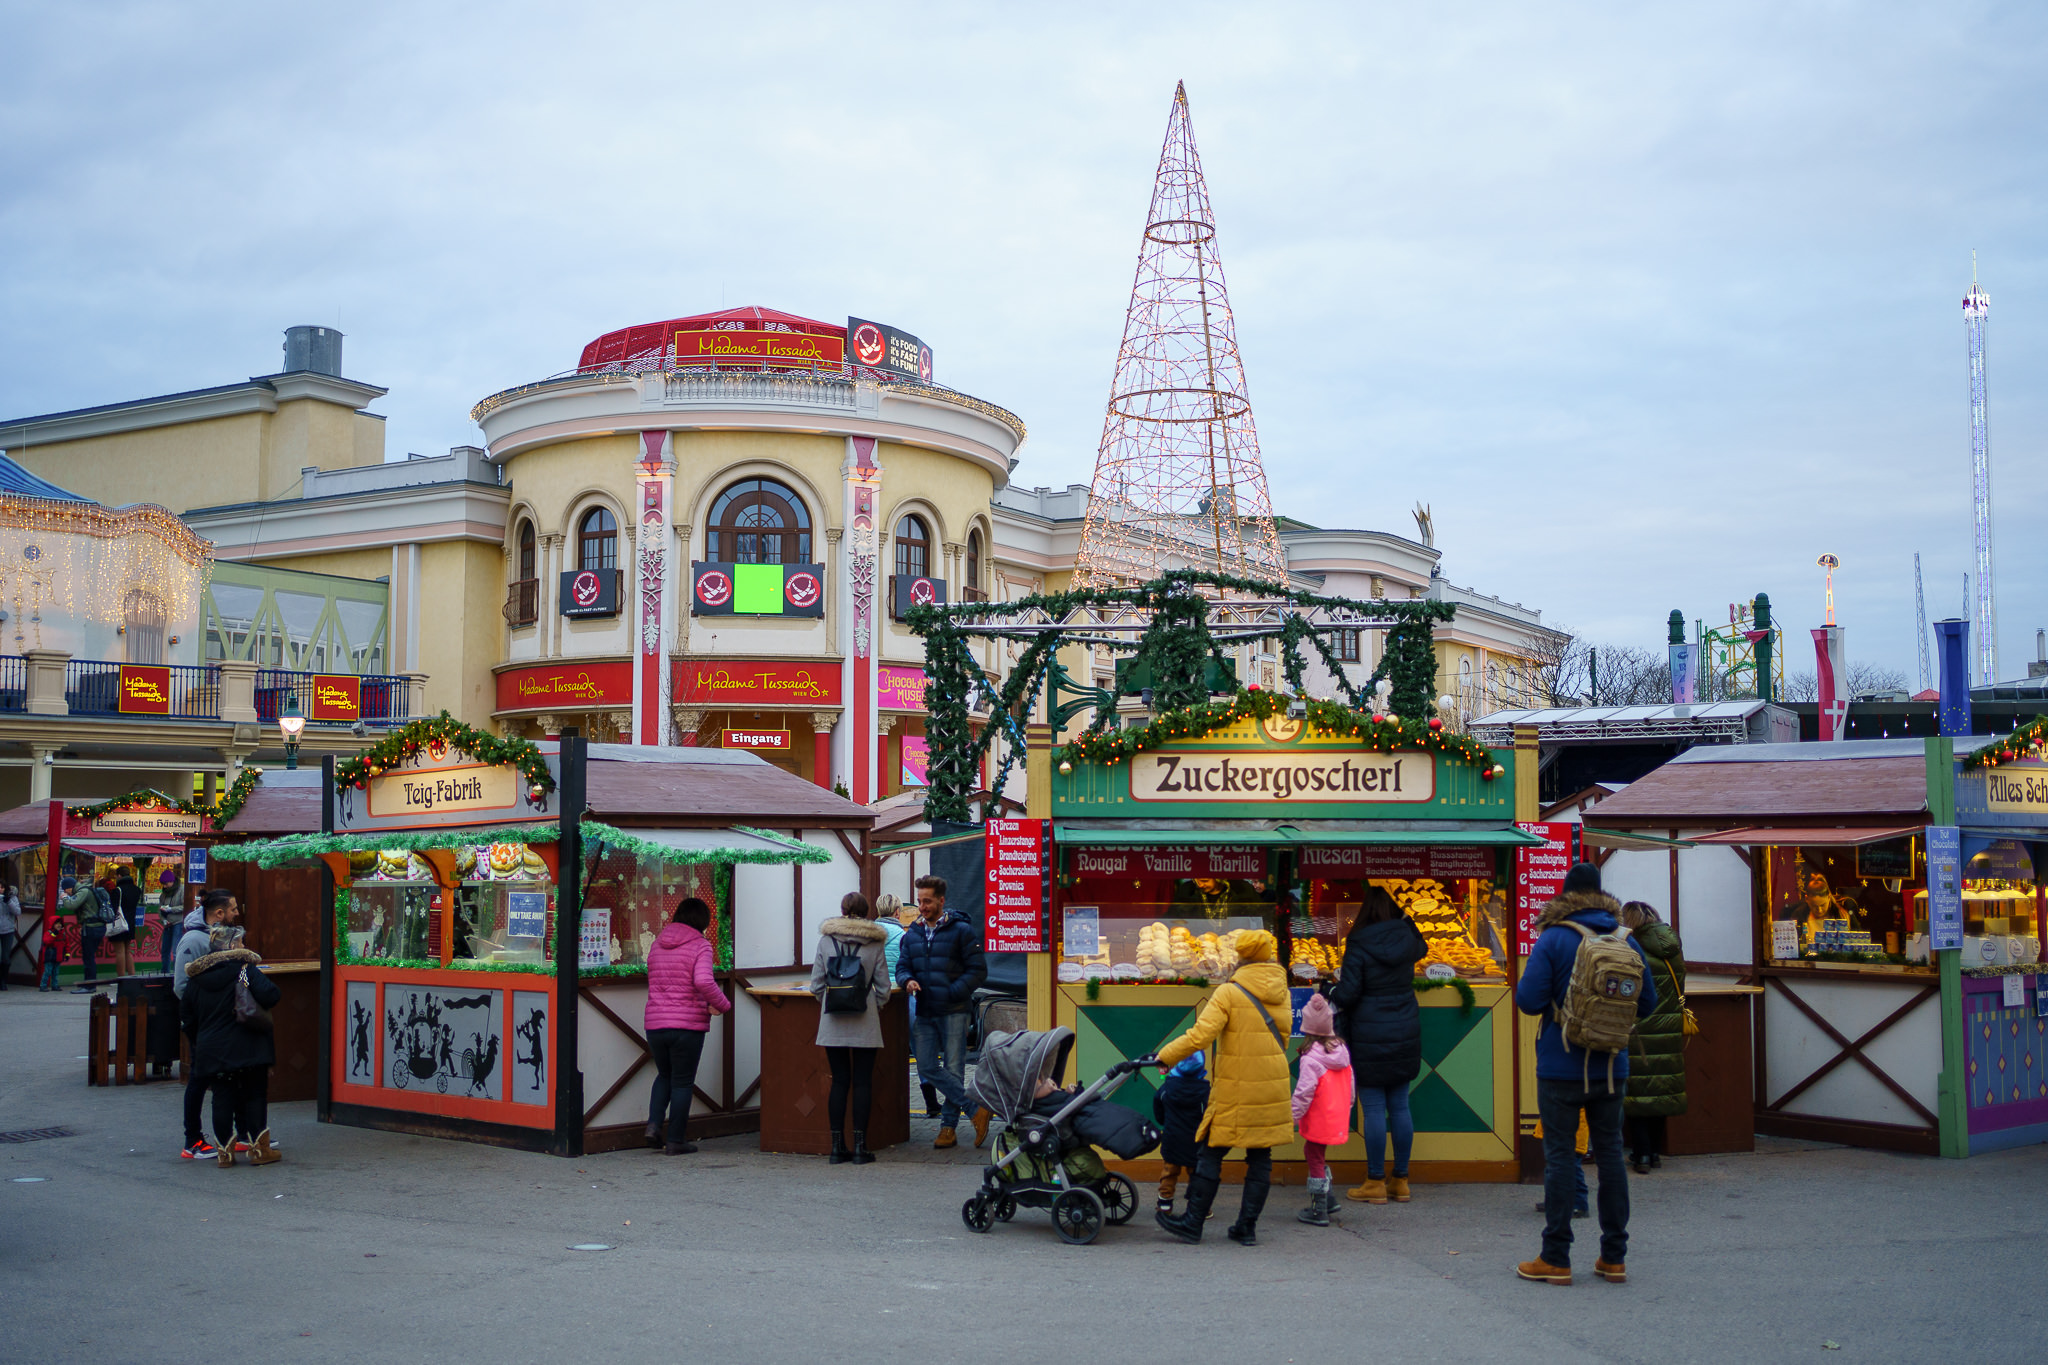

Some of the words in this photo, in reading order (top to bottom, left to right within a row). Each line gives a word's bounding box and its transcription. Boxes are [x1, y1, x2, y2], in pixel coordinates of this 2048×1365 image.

[698, 336, 760, 355] Madame
[757, 338, 826, 366] Tussauds
[900, 339, 918, 354] FOOD
[900, 350, 918, 364] FAST
[125, 676, 158, 688] Madame
[519, 676, 551, 696] Madame
[550, 672, 597, 698] Tussauds
[698, 670, 758, 690] Madame
[754, 670, 821, 698] Tussauds
[126, 687, 162, 702] Tussauds
[318, 686, 348, 696] Madame
[318, 696, 352, 710] Tussauds
[1270, 712, 1295, 732] 12
[732, 733, 782, 746] Eingang
[1156, 756, 1402, 798] Zuckergoscherl
[404, 776, 482, 808] Teig-Fabrik
[1990, 775, 2023, 802] Alles
[96, 817, 154, 828] Baumkuchen
[156, 818, 196, 829] Häuschen
[999, 820, 1019, 830] Brezen
[1529, 823, 1549, 834] Brezen
[999, 835, 1035, 848] Linzerstange
[999, 850, 1037, 863] Brandteigring
[1302, 846, 1362, 864] Riesen
[1366, 856, 1420, 865] Brandteigring
[1529, 854, 1567, 866] Brandteigring
[999, 865, 1040, 876] Sacherschnitte
[1078, 854, 1127, 874] Nougat
[1144, 855, 1192, 872] Vanille
[1209, 854, 1259, 872] Marille
[999, 880, 1024, 890] Brownies
[1529, 884, 1555, 894] Brownies
[532, 912, 544, 920] AWAY
[1430, 969, 1452, 977] Brezen
